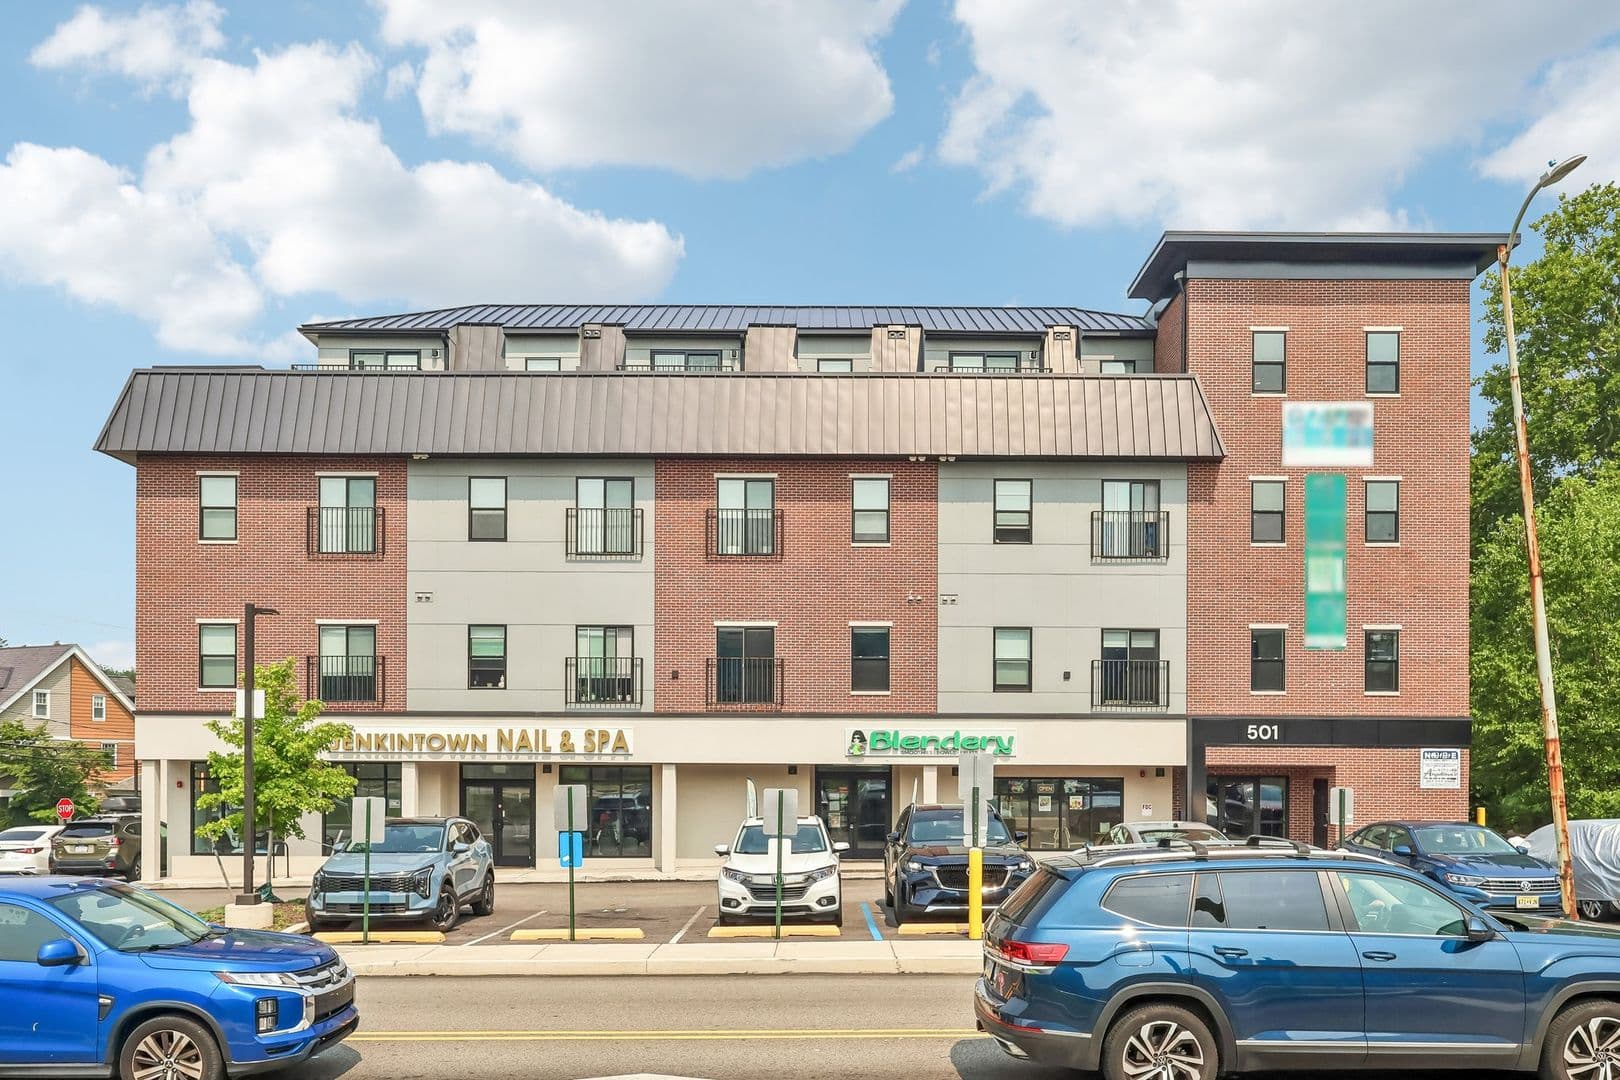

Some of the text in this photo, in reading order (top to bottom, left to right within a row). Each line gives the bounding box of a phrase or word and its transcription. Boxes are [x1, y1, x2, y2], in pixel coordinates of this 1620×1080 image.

[330, 729, 630, 753] JENKINTOWN NAIL & SPA
[1247, 724, 1279, 740] 501
[869, 730, 1014, 756] Blendery
[58, 805, 73, 813] STOP
